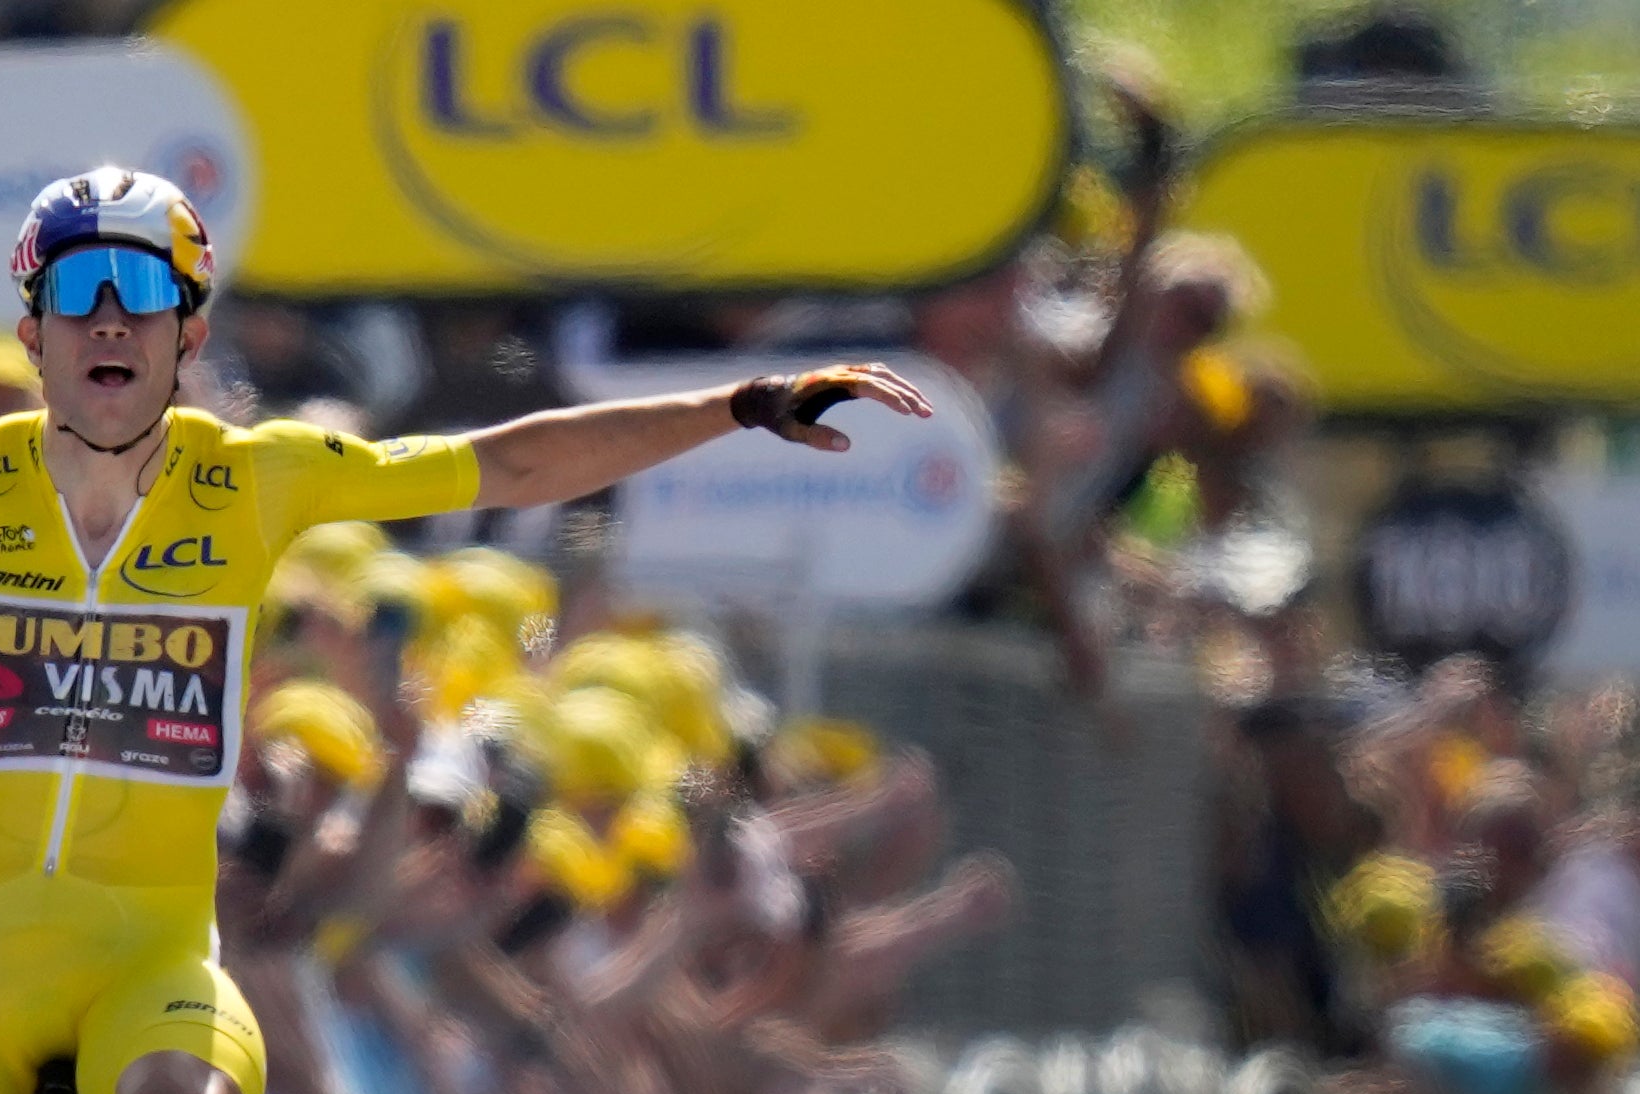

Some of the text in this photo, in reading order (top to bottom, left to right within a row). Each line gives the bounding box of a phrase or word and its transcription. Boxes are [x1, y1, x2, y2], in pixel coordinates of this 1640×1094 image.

[422, 18, 800, 140] LCL
[1416, 164, 1640, 284] LC
[193, 462, 239, 492] LCL
[134, 535, 227, 571] LCL
[44, 662, 209, 716] VISMA
[155, 721, 210, 742] HEMA
